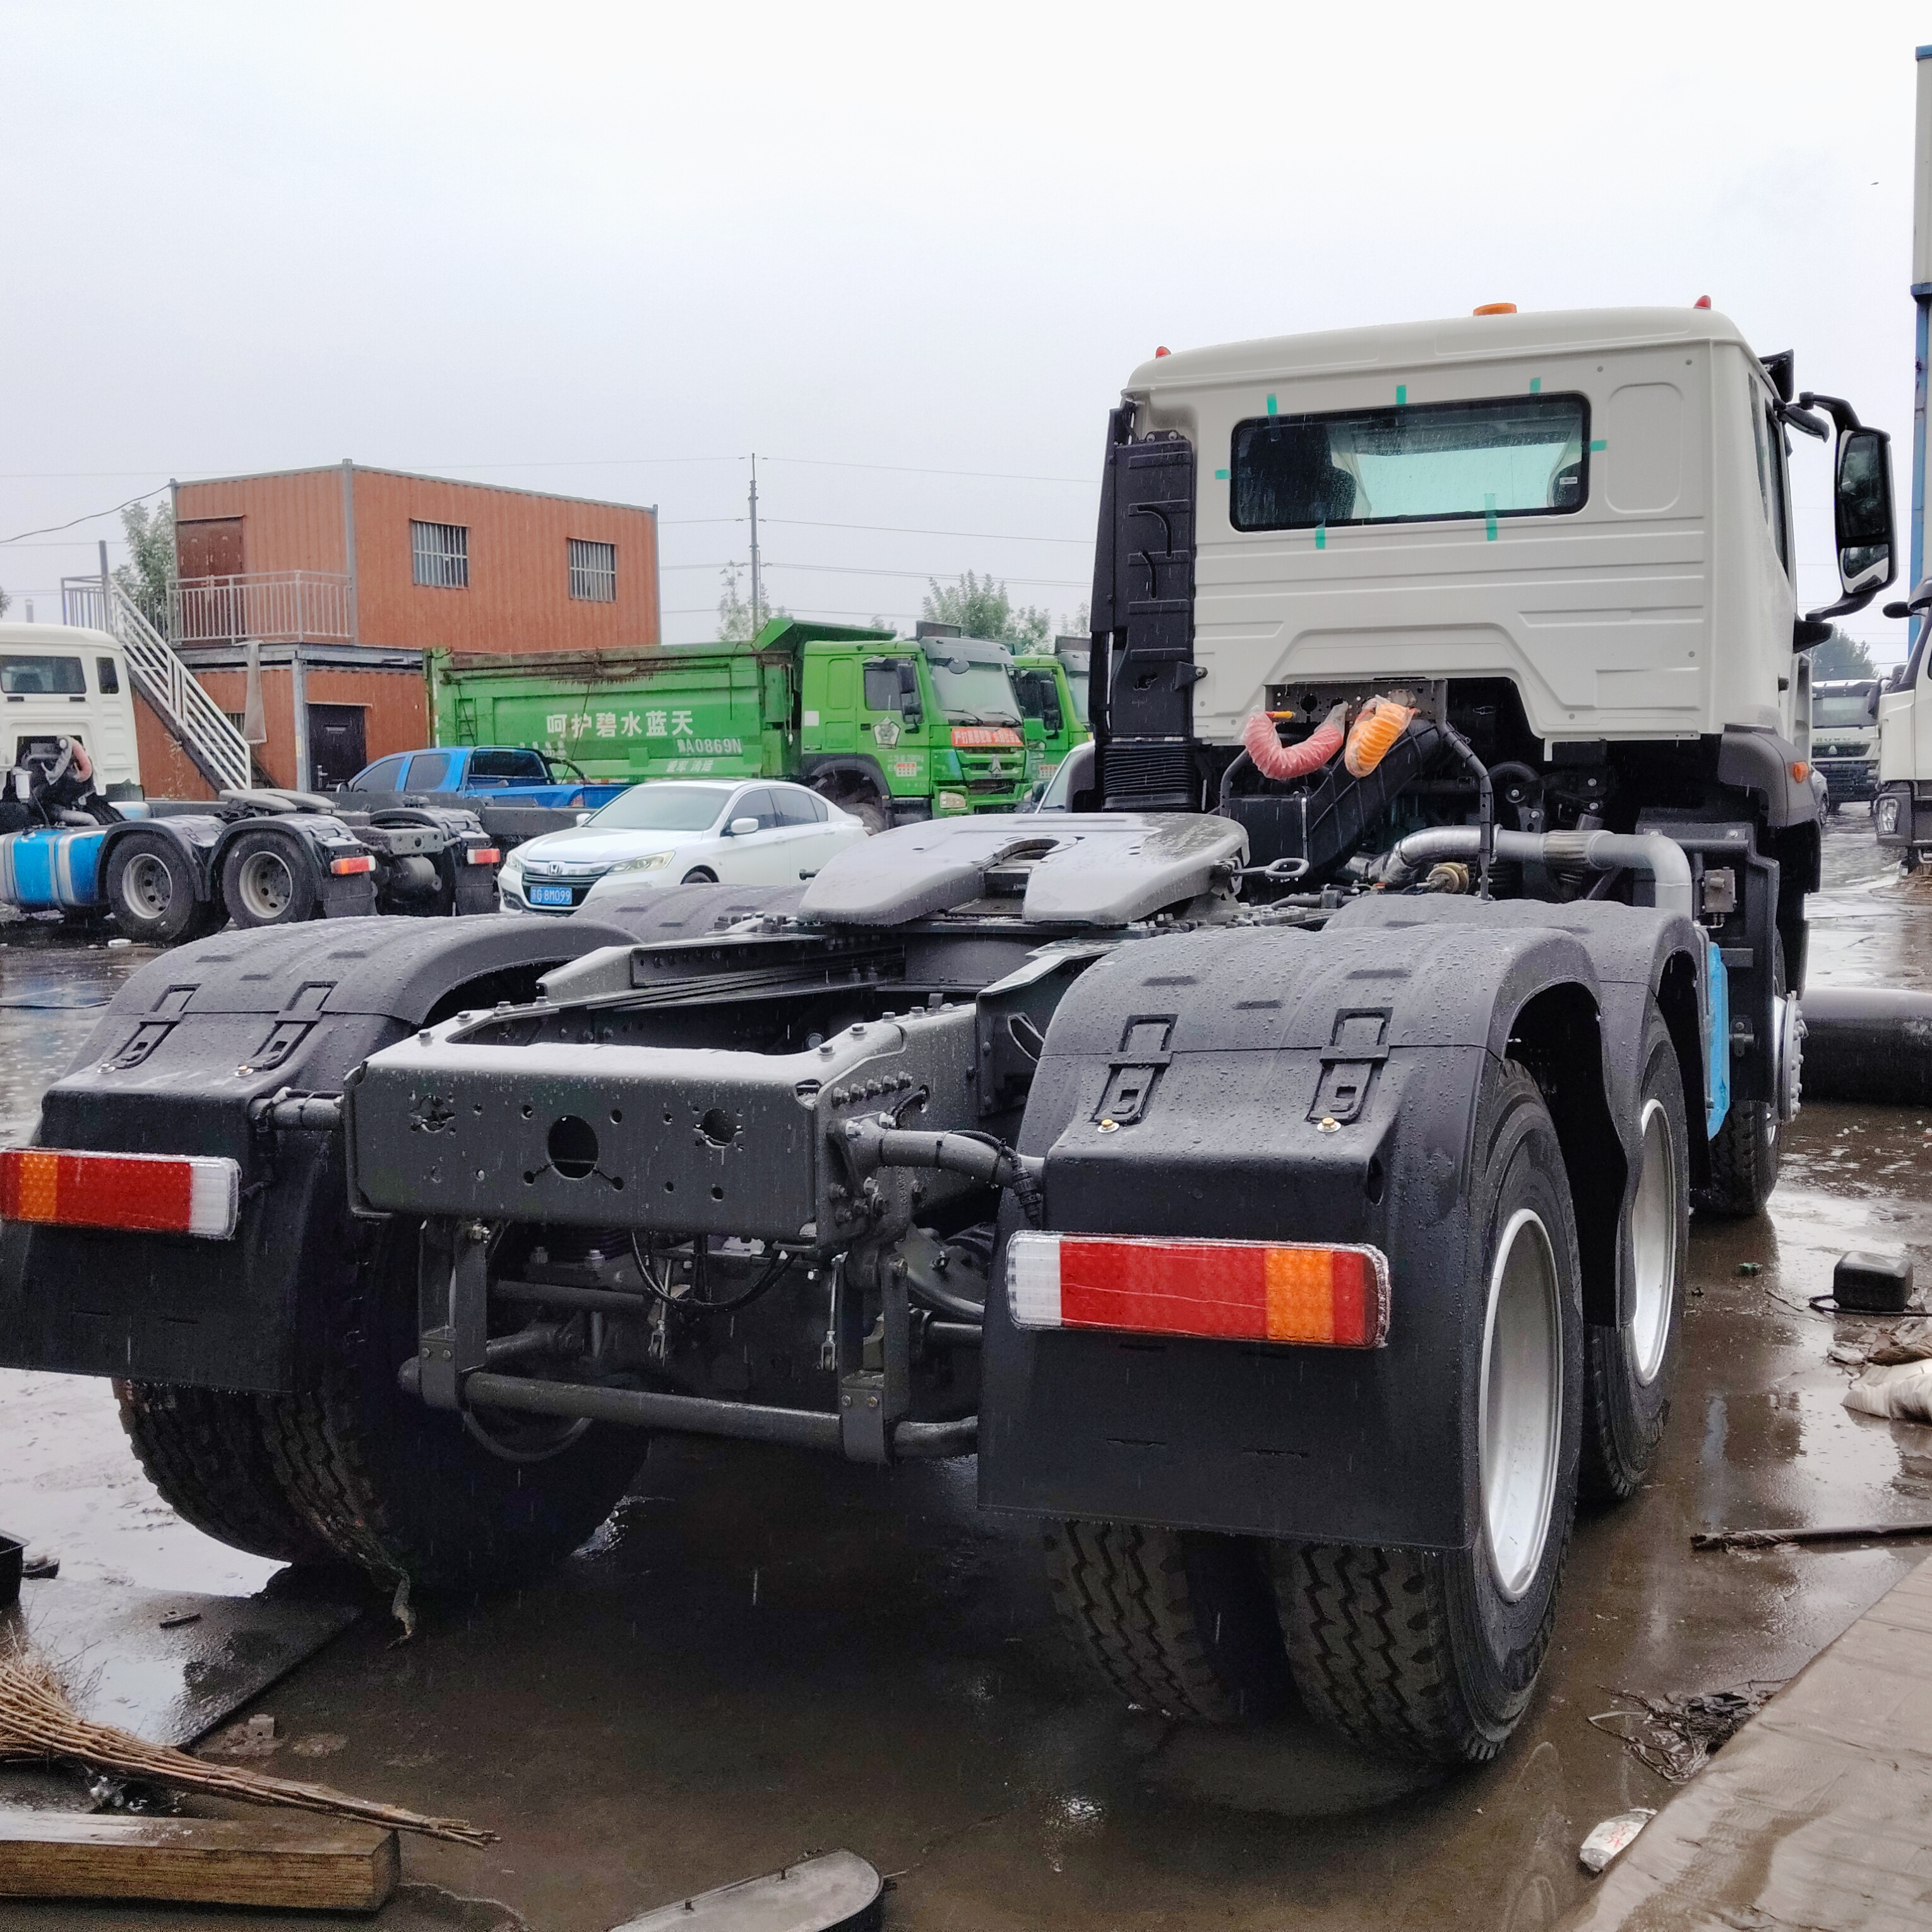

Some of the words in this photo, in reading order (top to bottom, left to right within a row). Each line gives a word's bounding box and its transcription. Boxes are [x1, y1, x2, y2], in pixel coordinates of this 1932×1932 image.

[547, 710, 694, 739] 呵护碧水蓝天
